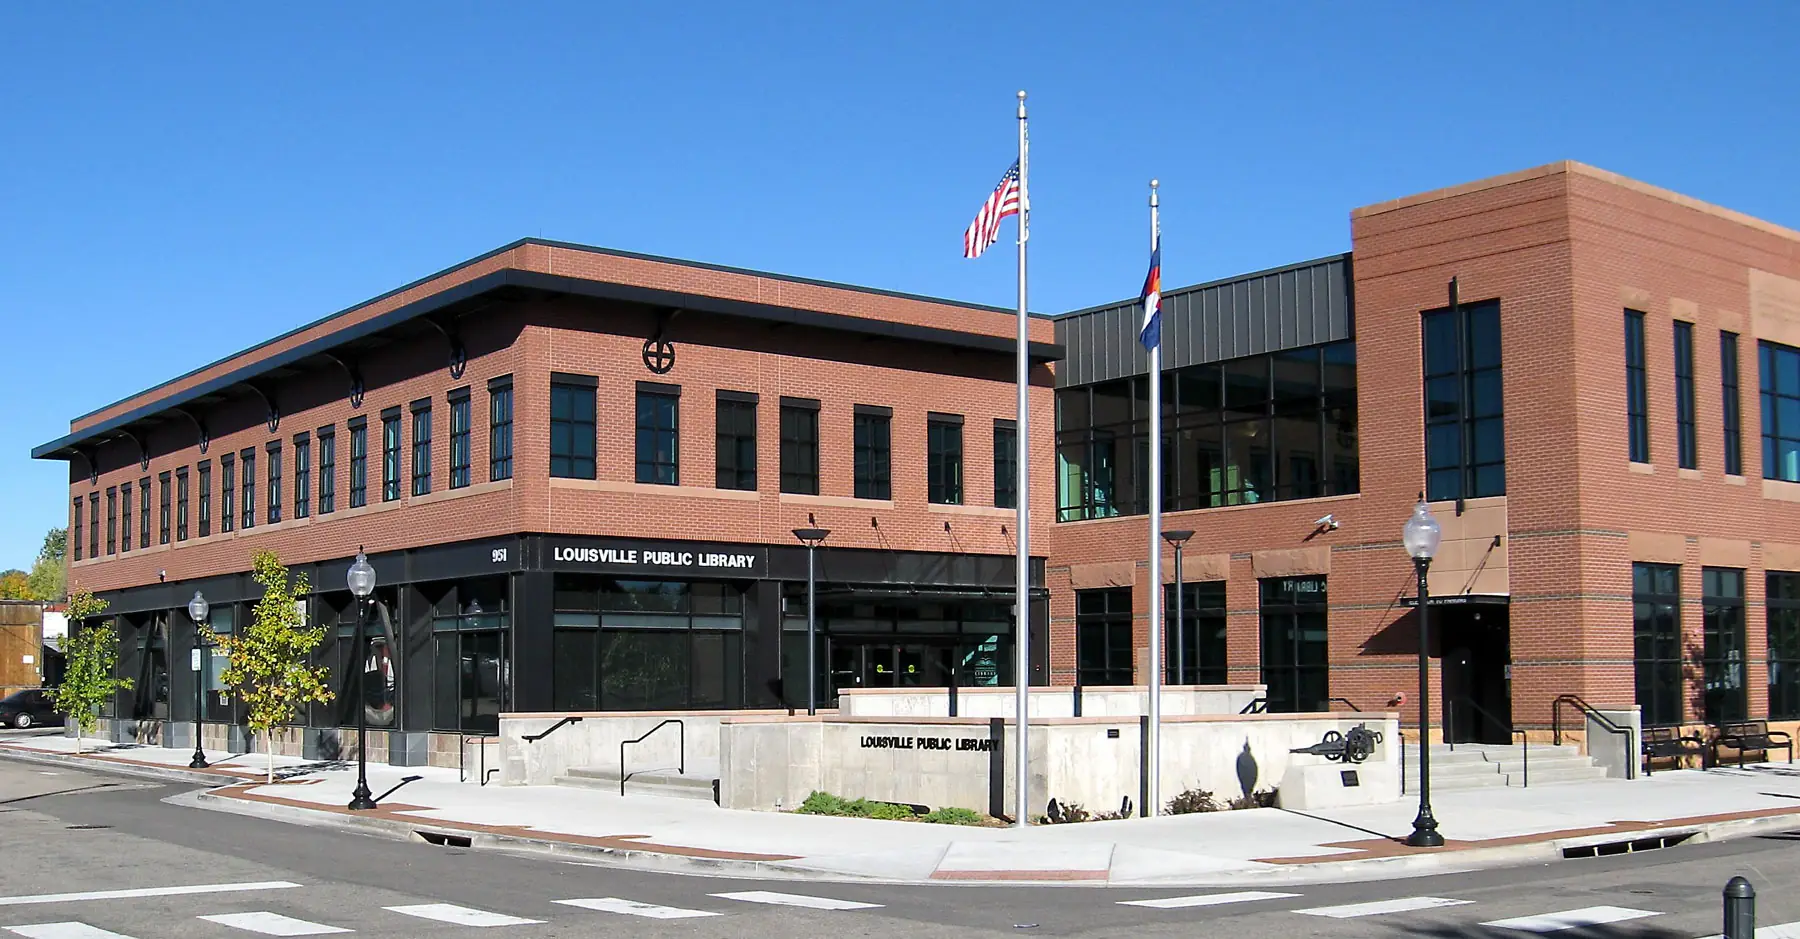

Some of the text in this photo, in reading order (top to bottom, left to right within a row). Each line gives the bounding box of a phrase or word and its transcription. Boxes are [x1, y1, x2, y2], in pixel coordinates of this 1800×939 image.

[492, 548, 507, 562] 951
[554, 547, 755, 568] LOUISVILLE PUBLIC LIBRARY
[860, 736, 1000, 752] LOUISVILLE PUBLIC LIBRARY
